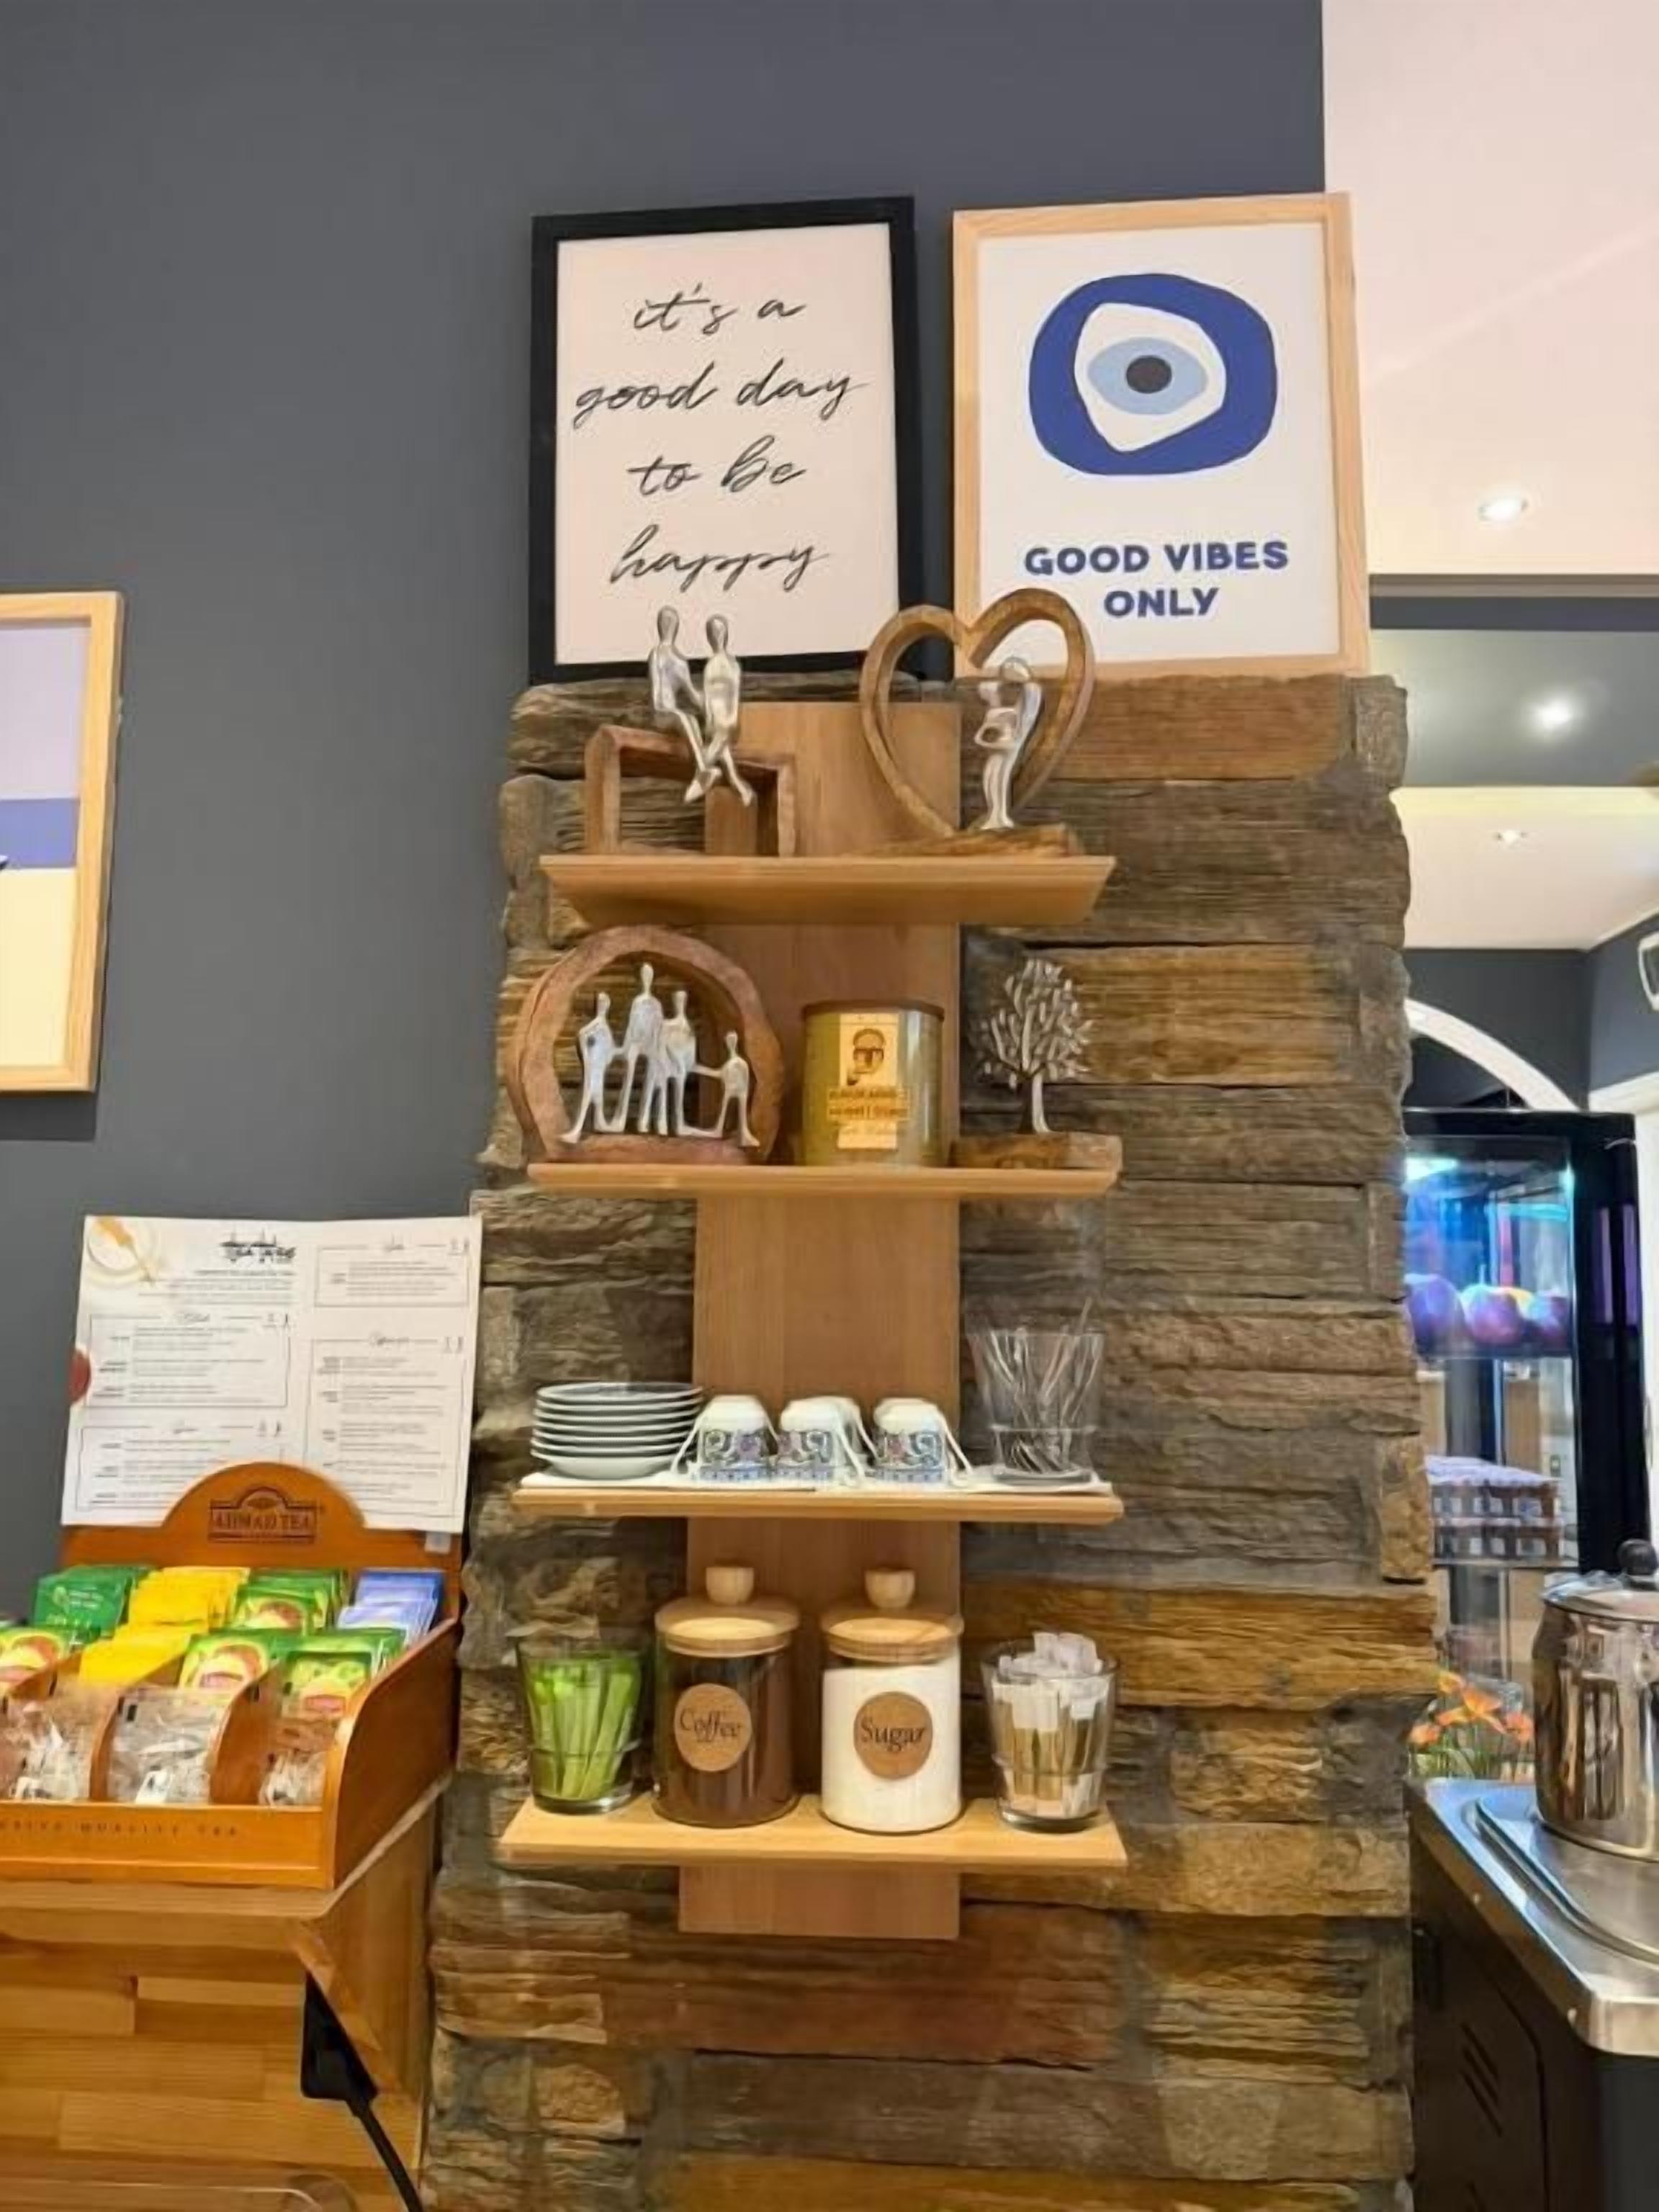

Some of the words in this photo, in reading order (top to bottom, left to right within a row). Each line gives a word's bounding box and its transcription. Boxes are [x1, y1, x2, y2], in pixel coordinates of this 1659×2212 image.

[634, 282, 738, 336] it's
[757, 299, 807, 320] a
[572, 360, 719, 431] good
[734, 356, 869, 422] day
[626, 454, 701, 497] to
[719, 434, 807, 493] be
[609, 523, 830, 593] happy
[1023, 544, 1151, 576] GOOD
[1163, 539, 1290, 573] VIBES
[1103, 586, 1220, 619] ONLY
[679, 1707, 744, 1743] Coffee
[860, 1716, 927, 1754] Sugar
